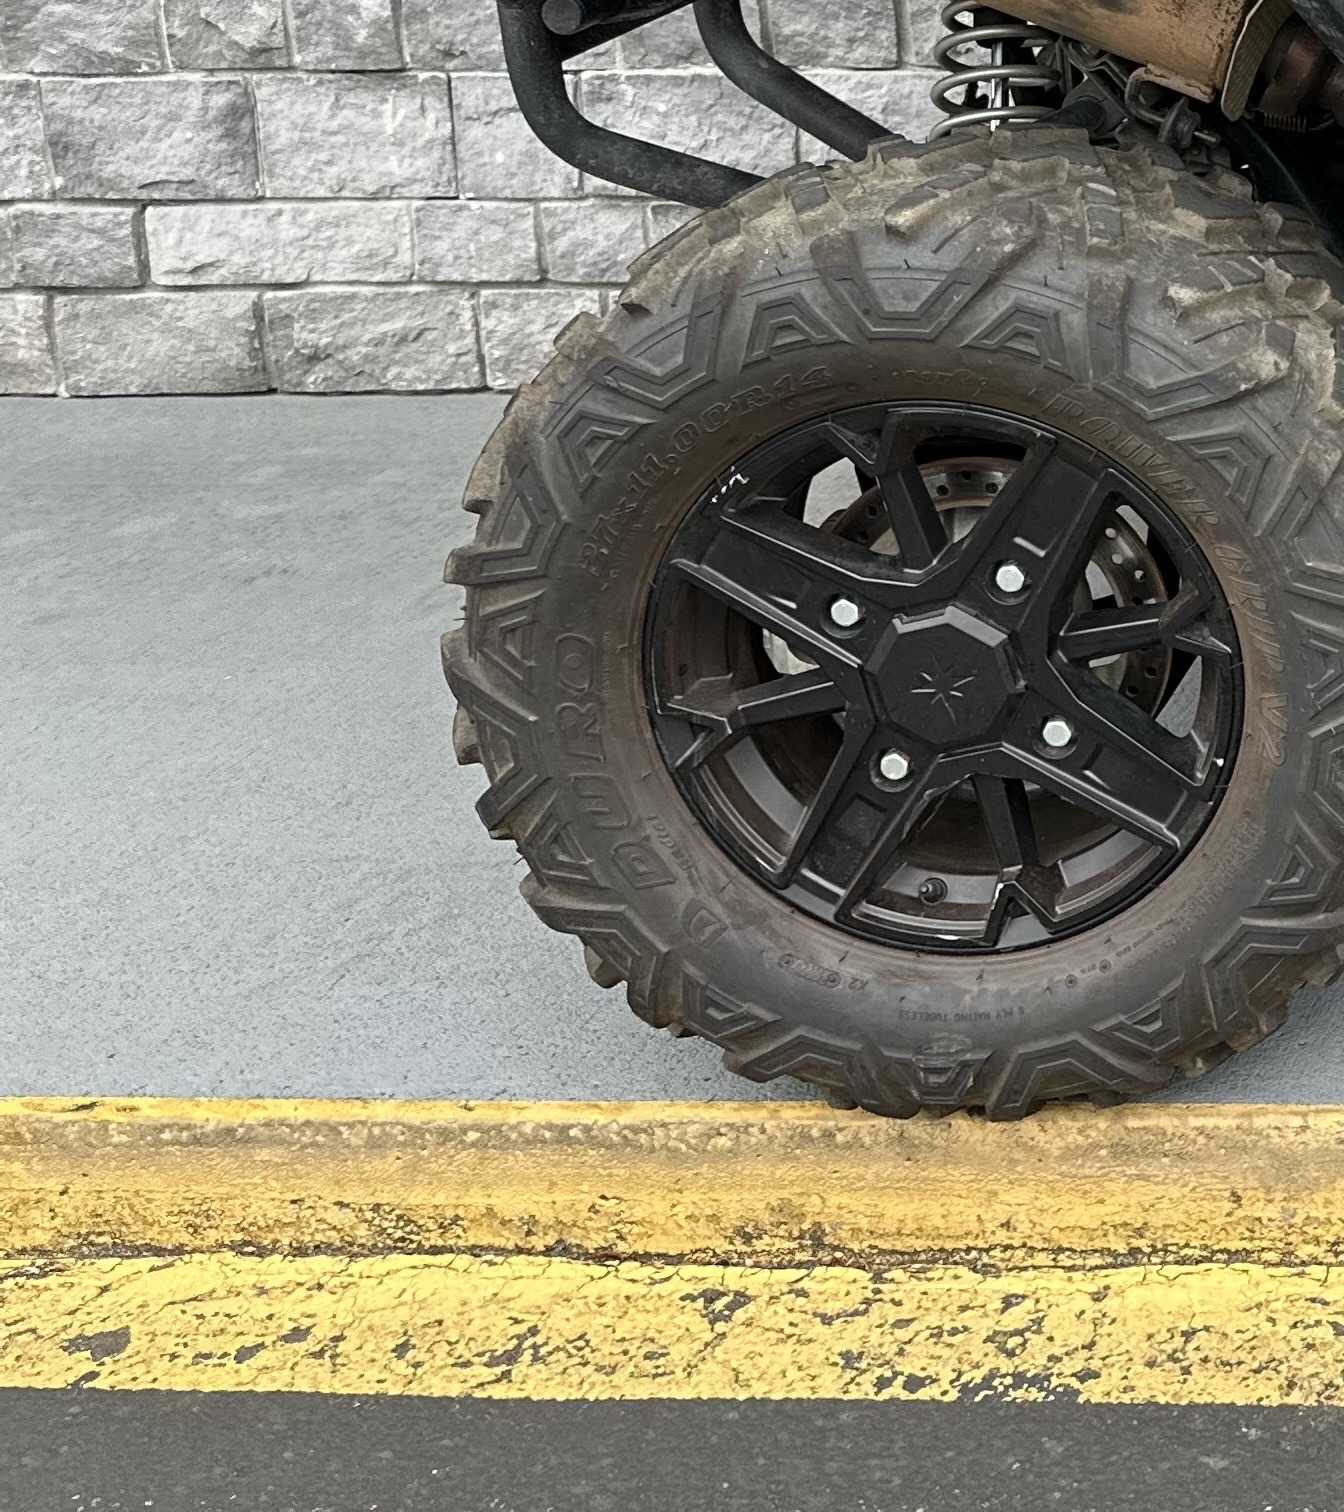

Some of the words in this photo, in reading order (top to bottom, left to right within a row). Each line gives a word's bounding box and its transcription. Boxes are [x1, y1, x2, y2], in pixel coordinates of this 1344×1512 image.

[1040, 393, 1220, 527] POWER
[1259, 692, 1289, 767] V2
[554, 632, 676, 888] DURO
